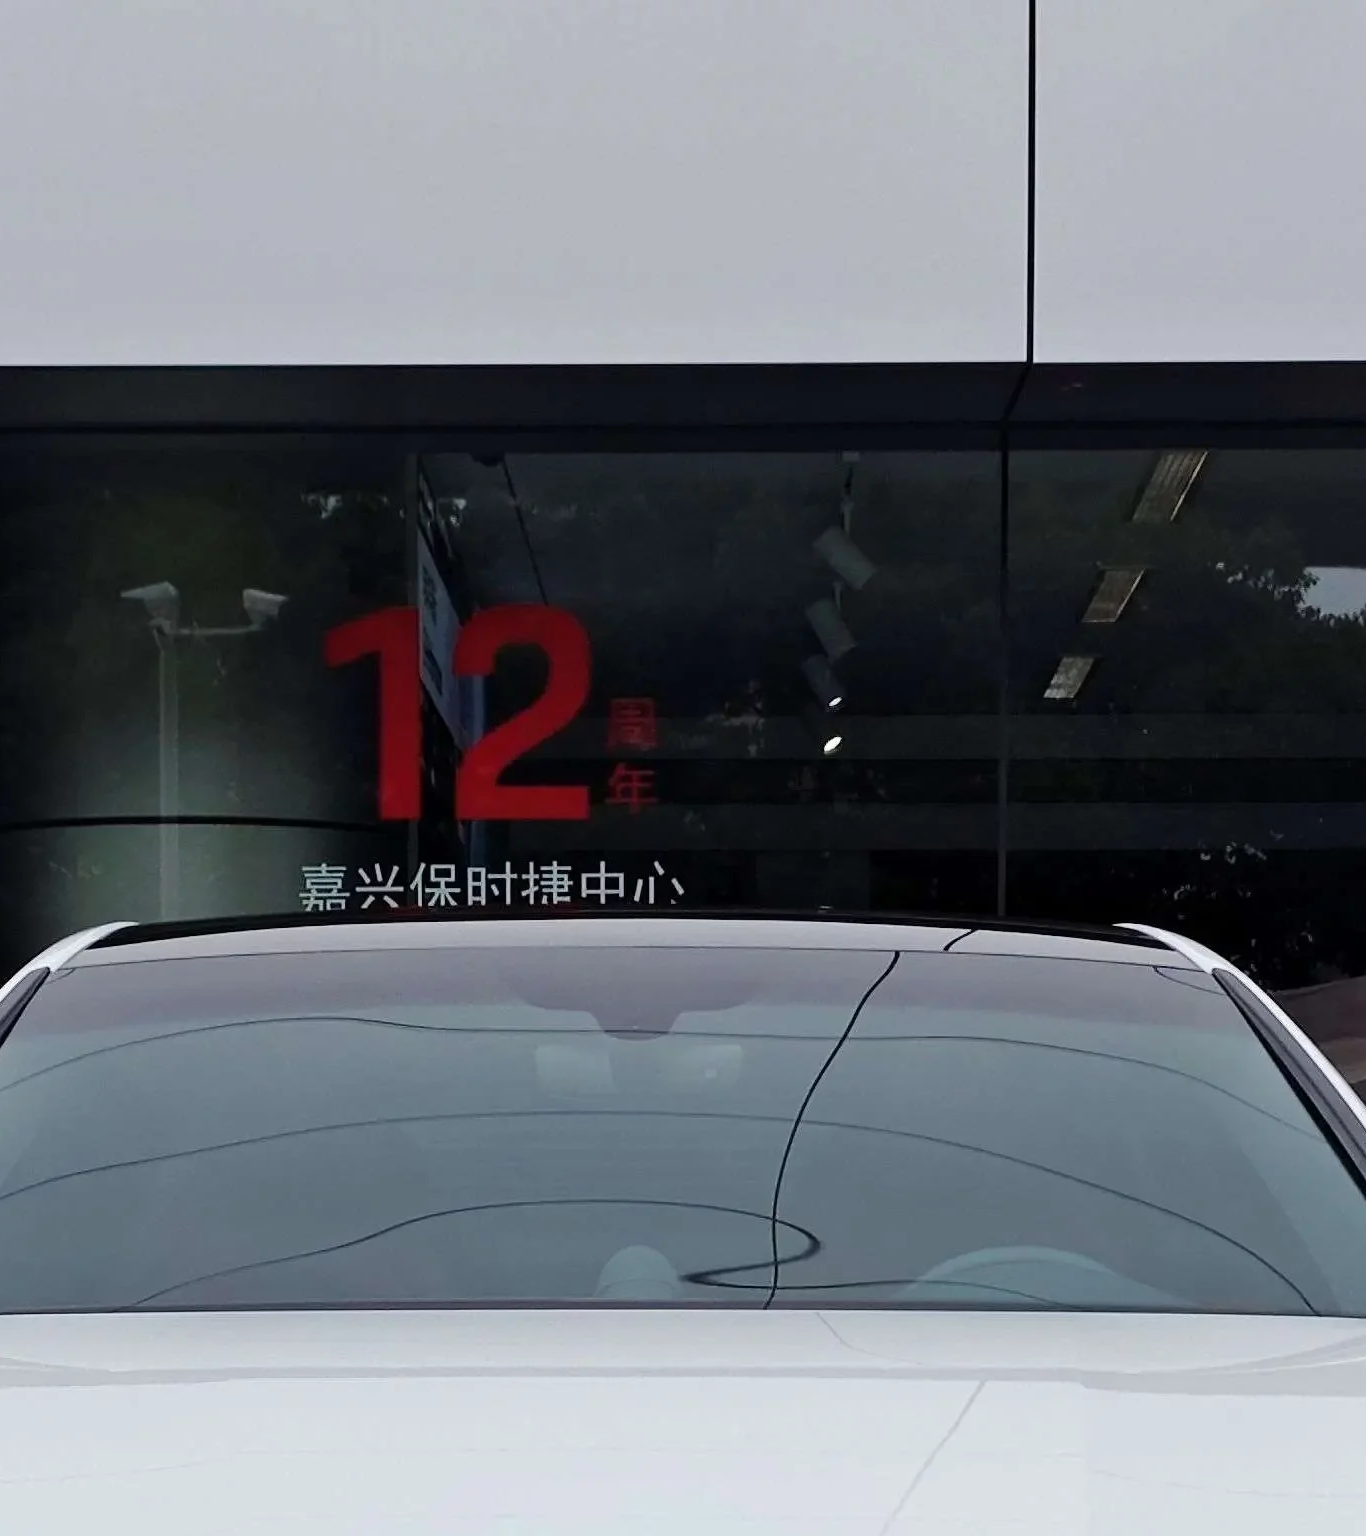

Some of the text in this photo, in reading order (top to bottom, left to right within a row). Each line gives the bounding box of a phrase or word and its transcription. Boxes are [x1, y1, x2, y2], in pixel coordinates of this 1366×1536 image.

[324, 604, 593, 821] 12
[604, 697, 659, 815] 周年
[299, 861, 685, 911] 嘉兴保时捷中心
